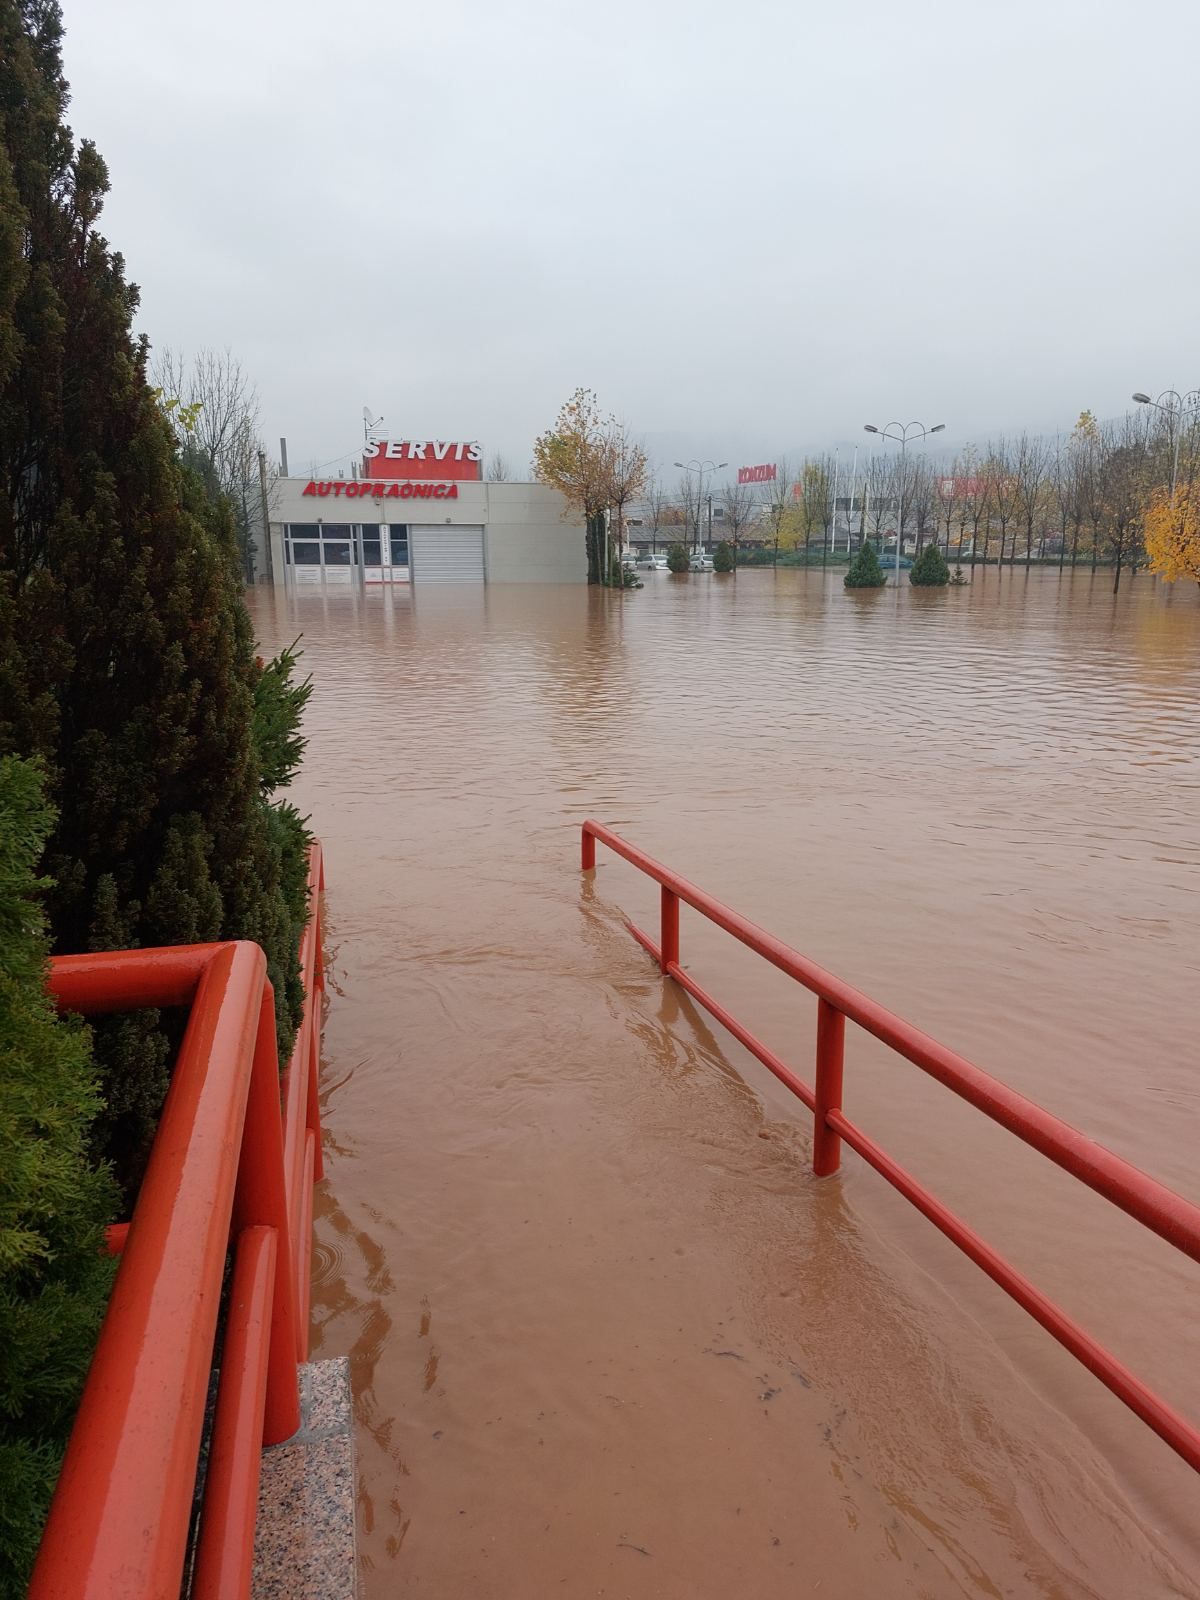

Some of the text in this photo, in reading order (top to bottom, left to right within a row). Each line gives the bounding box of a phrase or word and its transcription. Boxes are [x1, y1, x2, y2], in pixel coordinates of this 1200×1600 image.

[363, 438, 482, 461] SERVIS
[737, 463, 777, 485] KONZUM
[303, 482, 458, 499] AUTOPRAONICA
